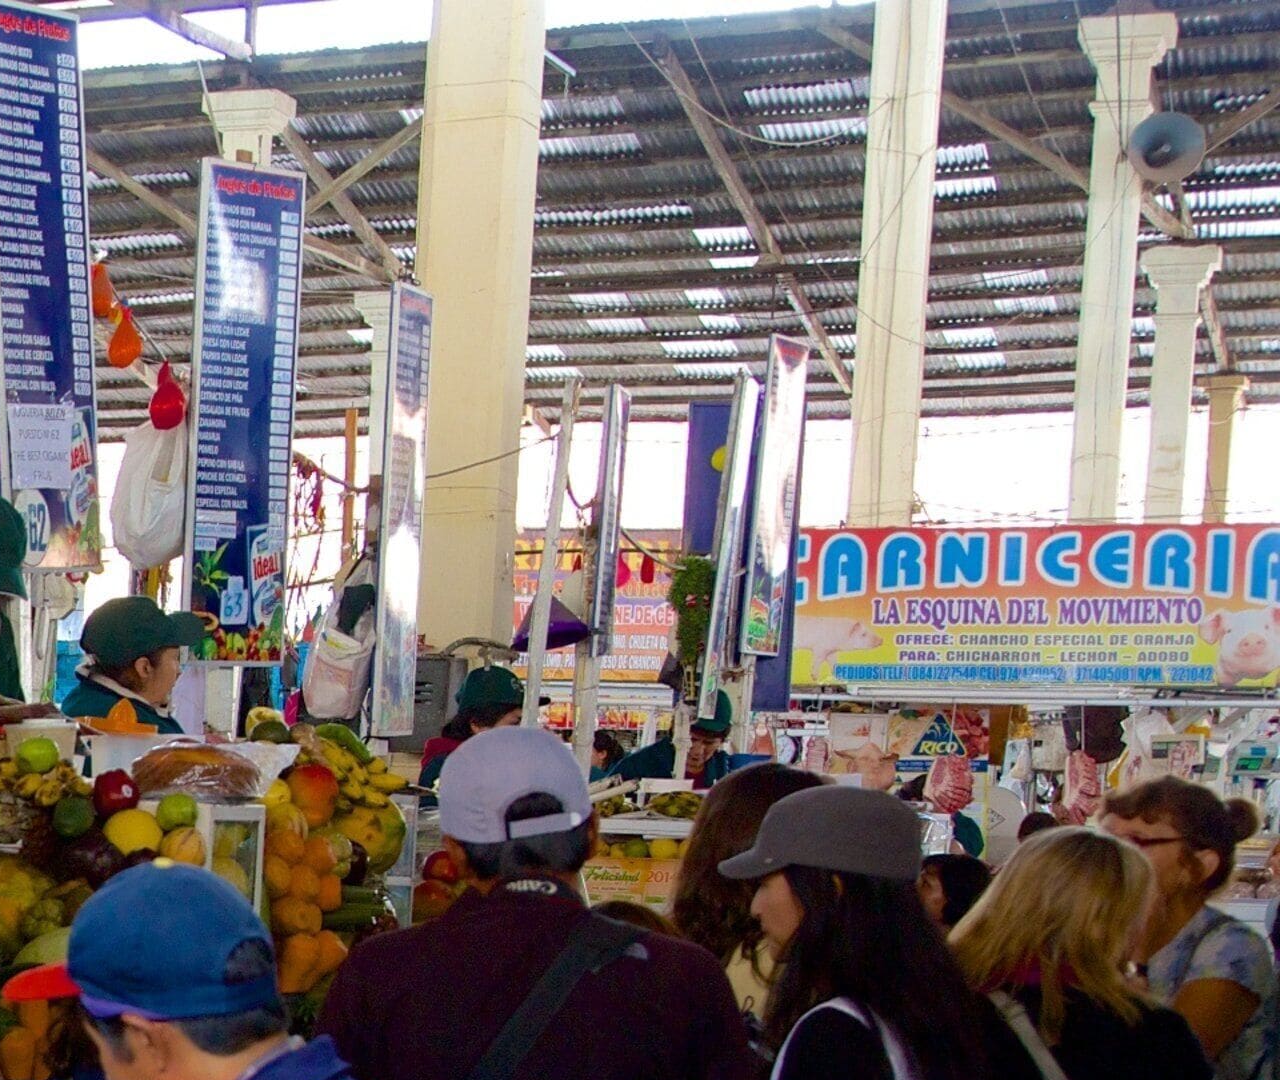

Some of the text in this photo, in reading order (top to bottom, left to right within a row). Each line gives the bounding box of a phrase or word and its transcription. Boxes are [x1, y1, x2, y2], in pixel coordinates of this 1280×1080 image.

[24, 16, 37, 35] de
[38, 19, 70, 42] Frutas
[70, 438, 90, 471] eal
[28, 503, 47, 552] 62
[253, 552, 279, 581] Ideal
[223, 593, 243, 616] 63
[635, 606, 653, 625] DE
[873, 598, 1202, 630] LA ESQUINA DEL MOVIMIENTO
[895, 634, 953, 645] OFRECE:
[1034, 635, 1104, 645] ESPECIAL
[1109, 635, 1128, 645] DE
[1133, 634, 1194, 645] GRANJA
[617, 656, 628, 668] DE
[899, 651, 1189, 662] PARA: CHICHARRON LECHON ADOBO
[919, 740, 959, 754] RICO
